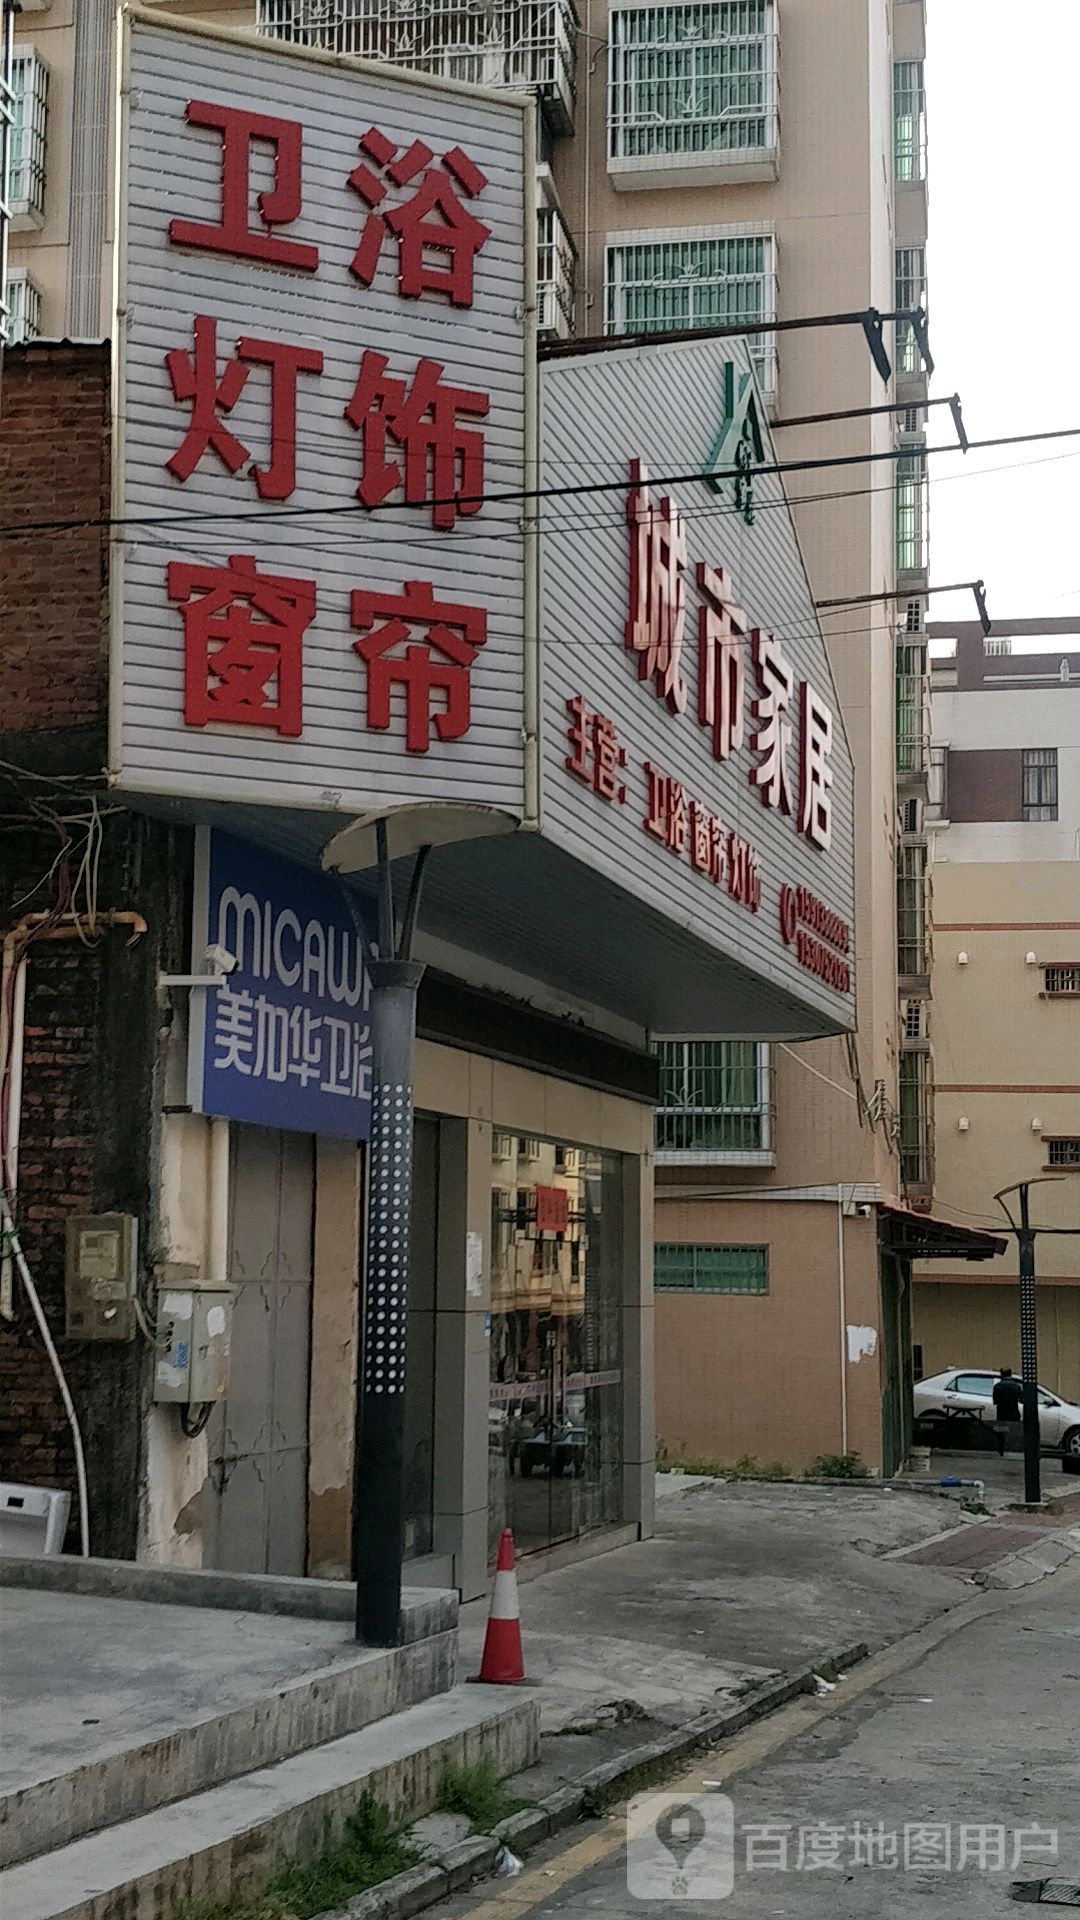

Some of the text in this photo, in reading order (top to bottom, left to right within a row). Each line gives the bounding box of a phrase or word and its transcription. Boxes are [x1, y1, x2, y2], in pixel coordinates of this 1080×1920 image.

[168, 99, 492, 308] 卫浴
[165, 315, 488, 530] 灯饰
[167, 554, 488, 753] 窗帘
[626, 458, 834, 852] 城市家居
